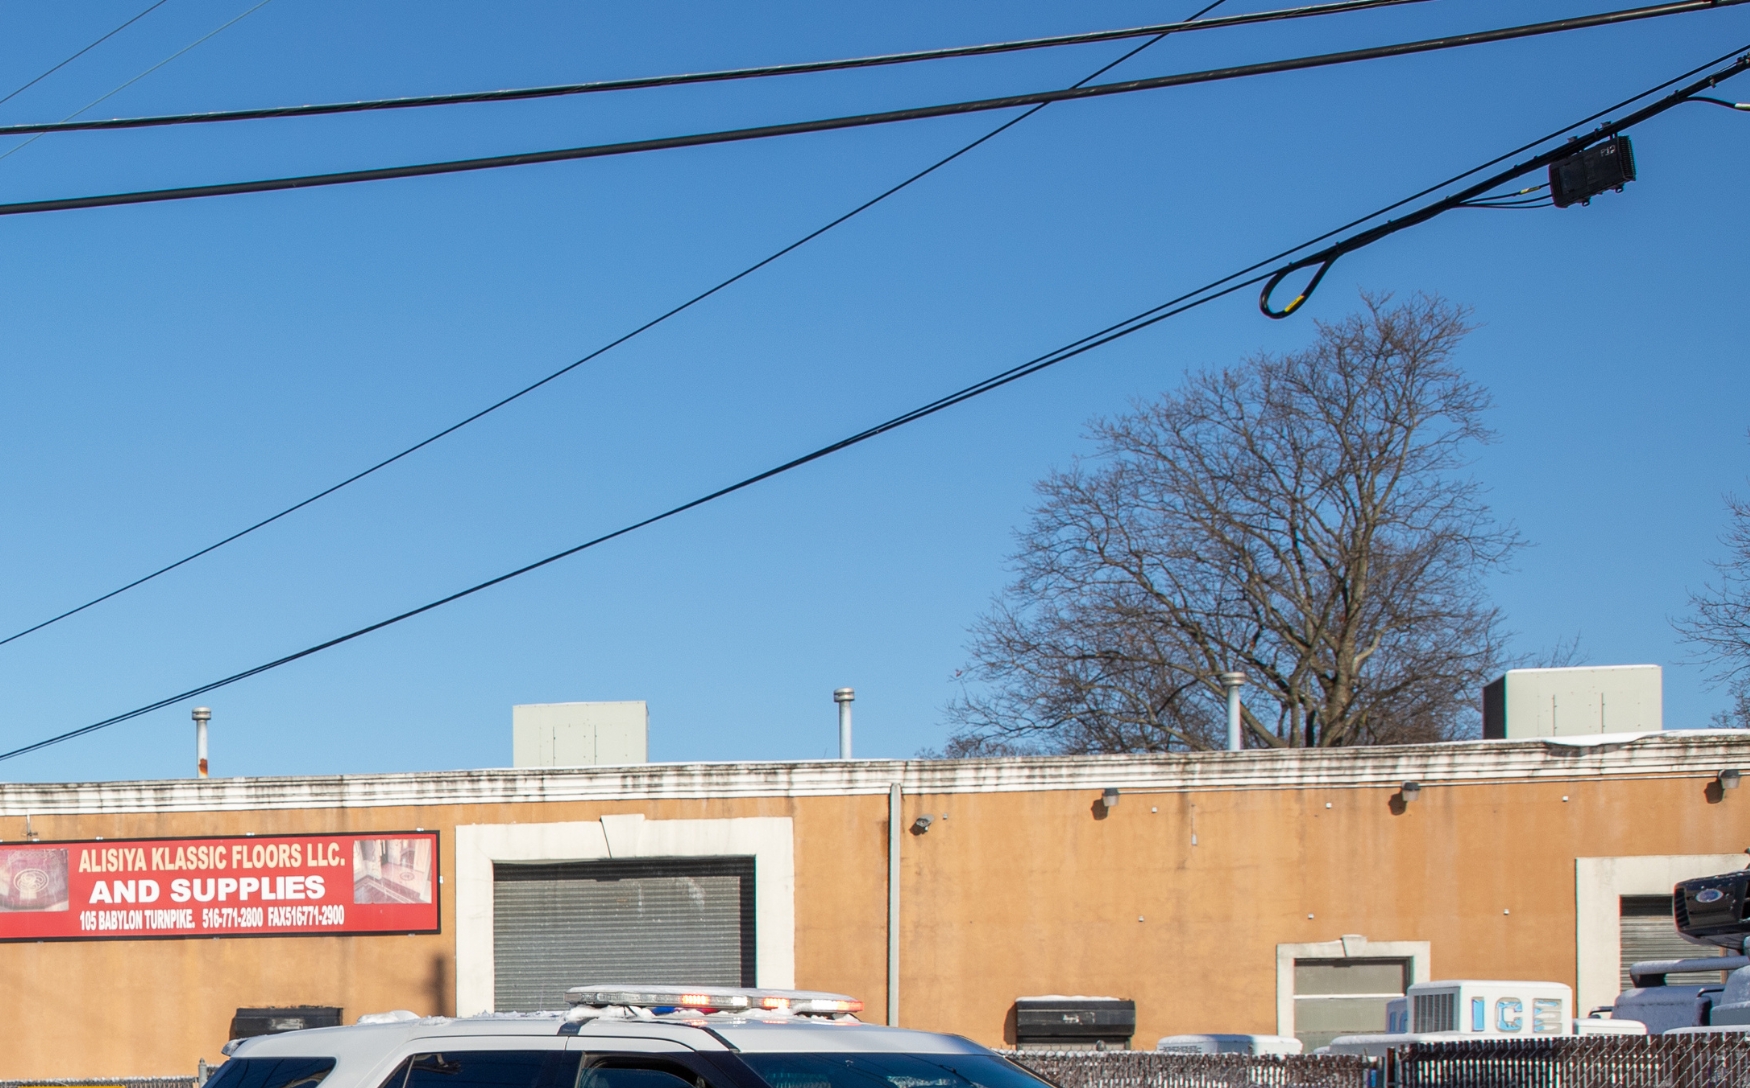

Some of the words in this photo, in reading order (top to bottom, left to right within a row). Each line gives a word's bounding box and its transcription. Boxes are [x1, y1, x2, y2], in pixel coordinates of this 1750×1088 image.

[78, 848, 147, 873] ALISIYA
[151, 846, 227, 871] KLASSIC
[232, 844, 301, 869] FLOORS
[307, 843, 345, 867] LLC.
[88, 879, 160, 904] AND
[170, 875, 326, 902] SUPPLIES
[79, 910, 97, 930] 105
[98, 909, 143, 930] BABYLON
[144, 908, 195, 929] TURNPIKE.
[202, 907, 263, 928] 516-771-2800
[1471, 996, 1563, 1034] ICE
